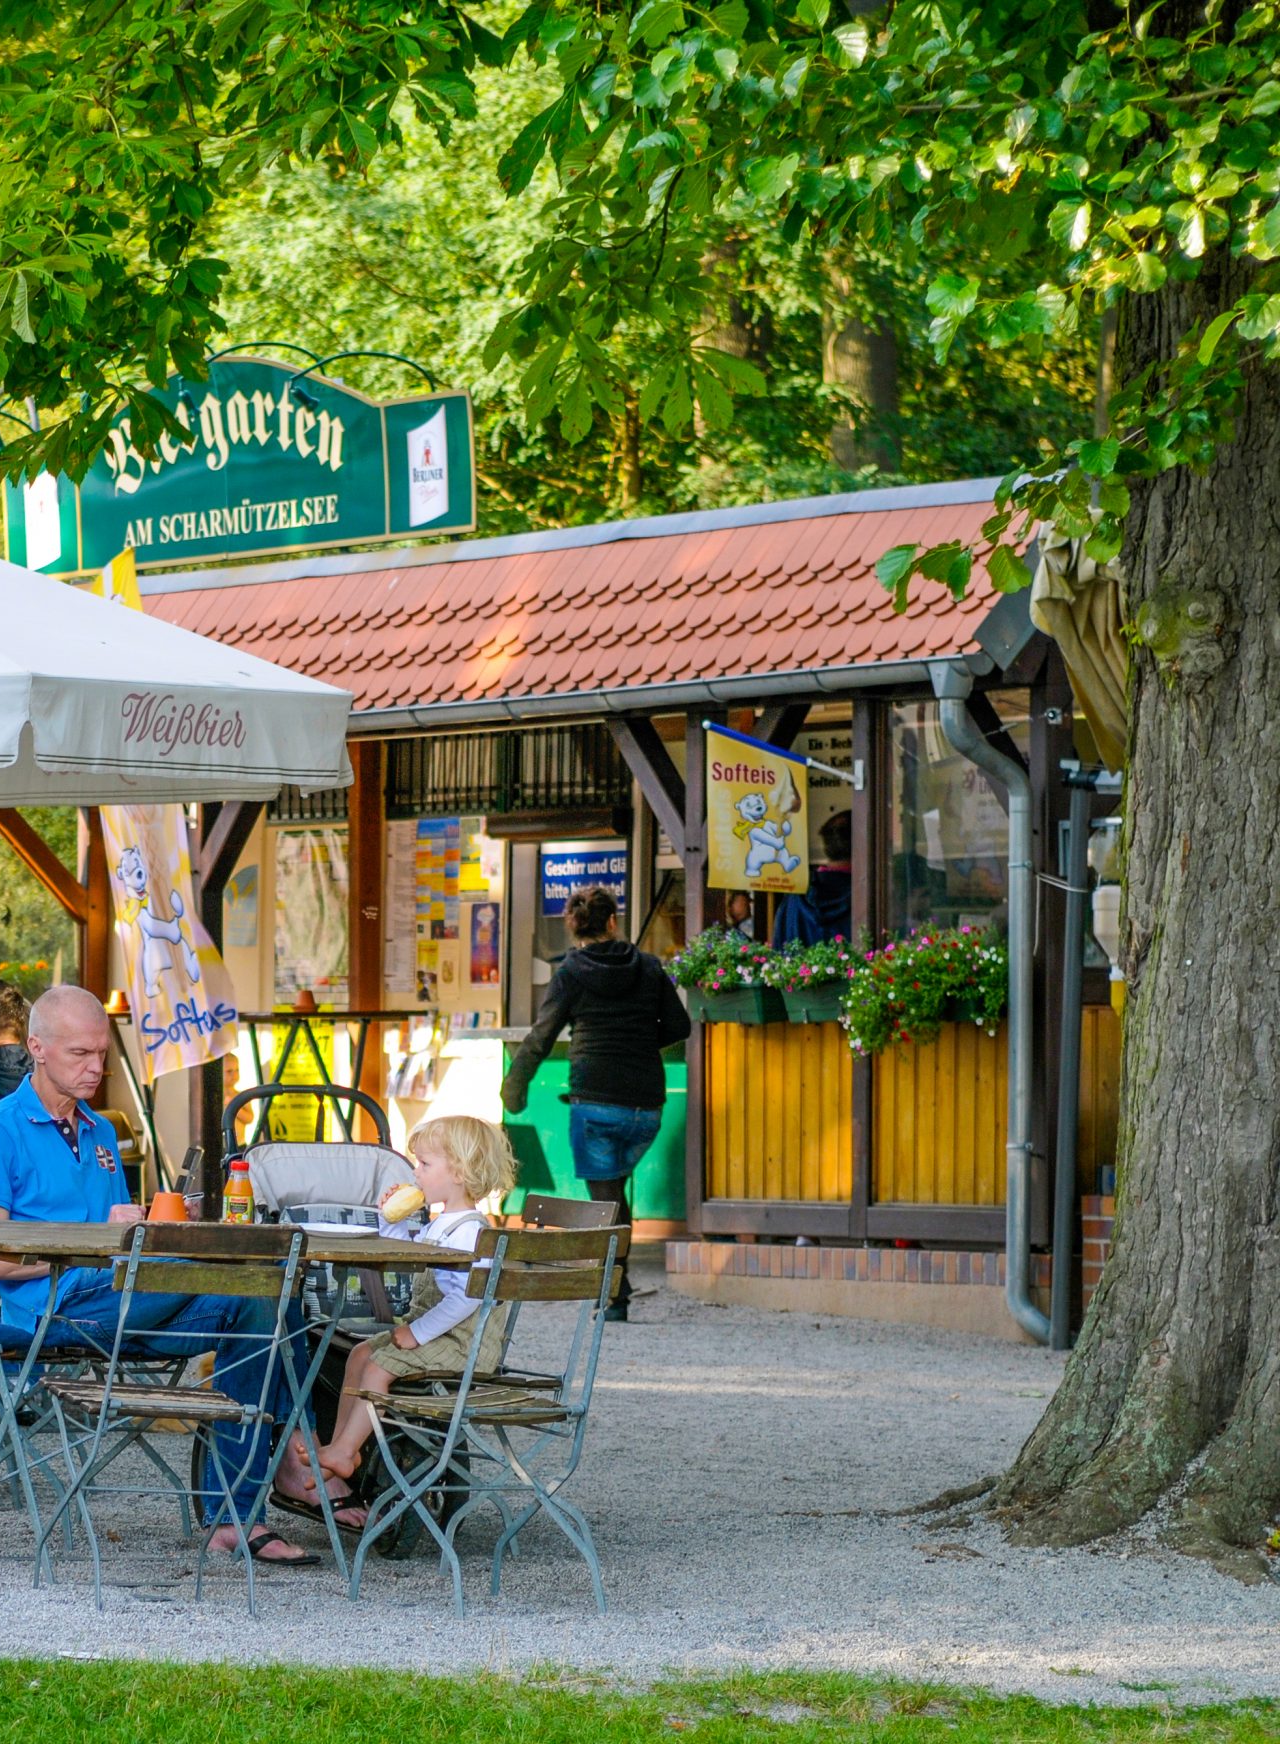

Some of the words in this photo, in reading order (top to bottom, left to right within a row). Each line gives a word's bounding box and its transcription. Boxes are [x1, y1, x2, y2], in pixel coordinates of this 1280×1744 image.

[412, 467, 444, 484] BERLINER
[123, 518, 153, 548] AM
[159, 495, 339, 544] SCHARMÜTZELSEE
[121, 692, 246, 757] Weißbier
[712, 761, 776, 785] Softeis
[545, 859, 585, 877] Geschirr
[587, 858, 607, 874] und
[545, 882, 569, 899] bitte
